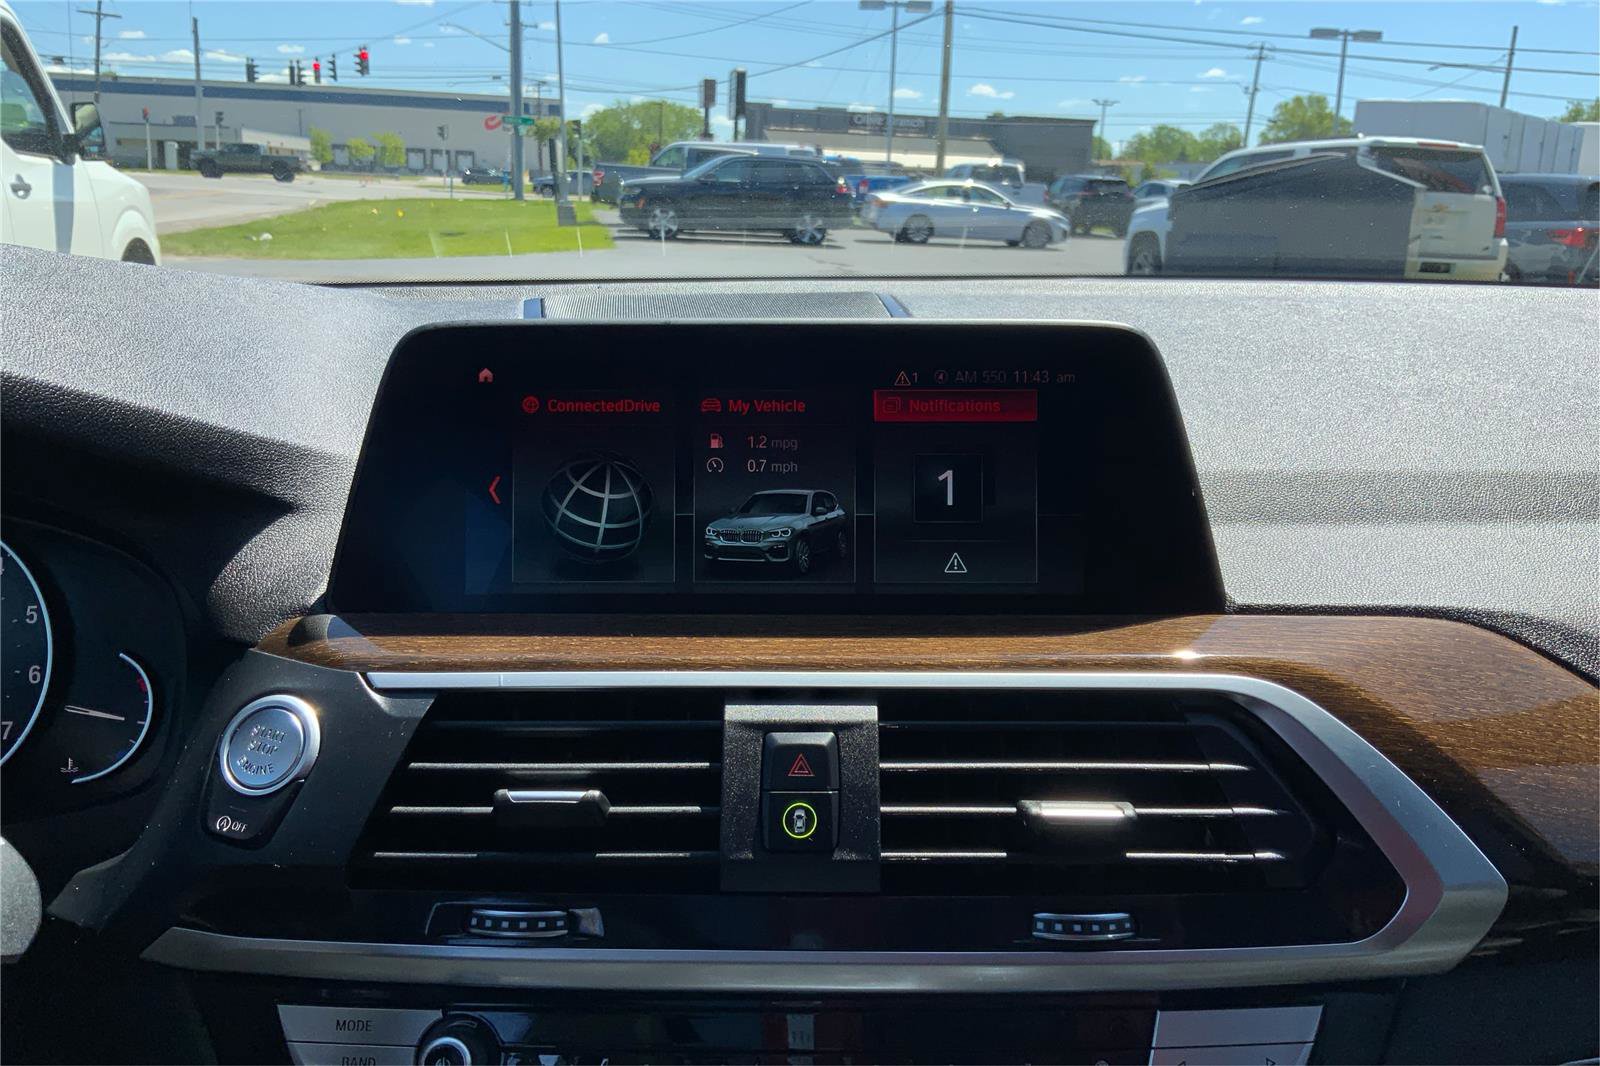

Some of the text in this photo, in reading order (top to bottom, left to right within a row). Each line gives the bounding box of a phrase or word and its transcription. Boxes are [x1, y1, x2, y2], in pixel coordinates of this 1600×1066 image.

[911, 370, 1076, 383] 1 AM 550 11:43 am
[547, 398, 661, 413] ConnectedDrive
[728, 399, 806, 415] My Vehicle
[909, 399, 1001, 413] Notifications
[747, 435, 798, 450] 1.2 mpg
[747, 459, 798, 474] 0.7 mph
[937, 469, 954, 506] 1
[25, 605, 38, 624] 5
[28, 665, 41, 684] 6
[0, 720, 14, 741] 7
[251, 724, 287, 743] START
[247, 740, 279, 756] STOP
[236, 753, 275, 776] ENGINE
[231, 821, 248, 833] OFF
[335, 1019, 374, 1032] MODE
[342, 1056, 376, 1066] BAND
